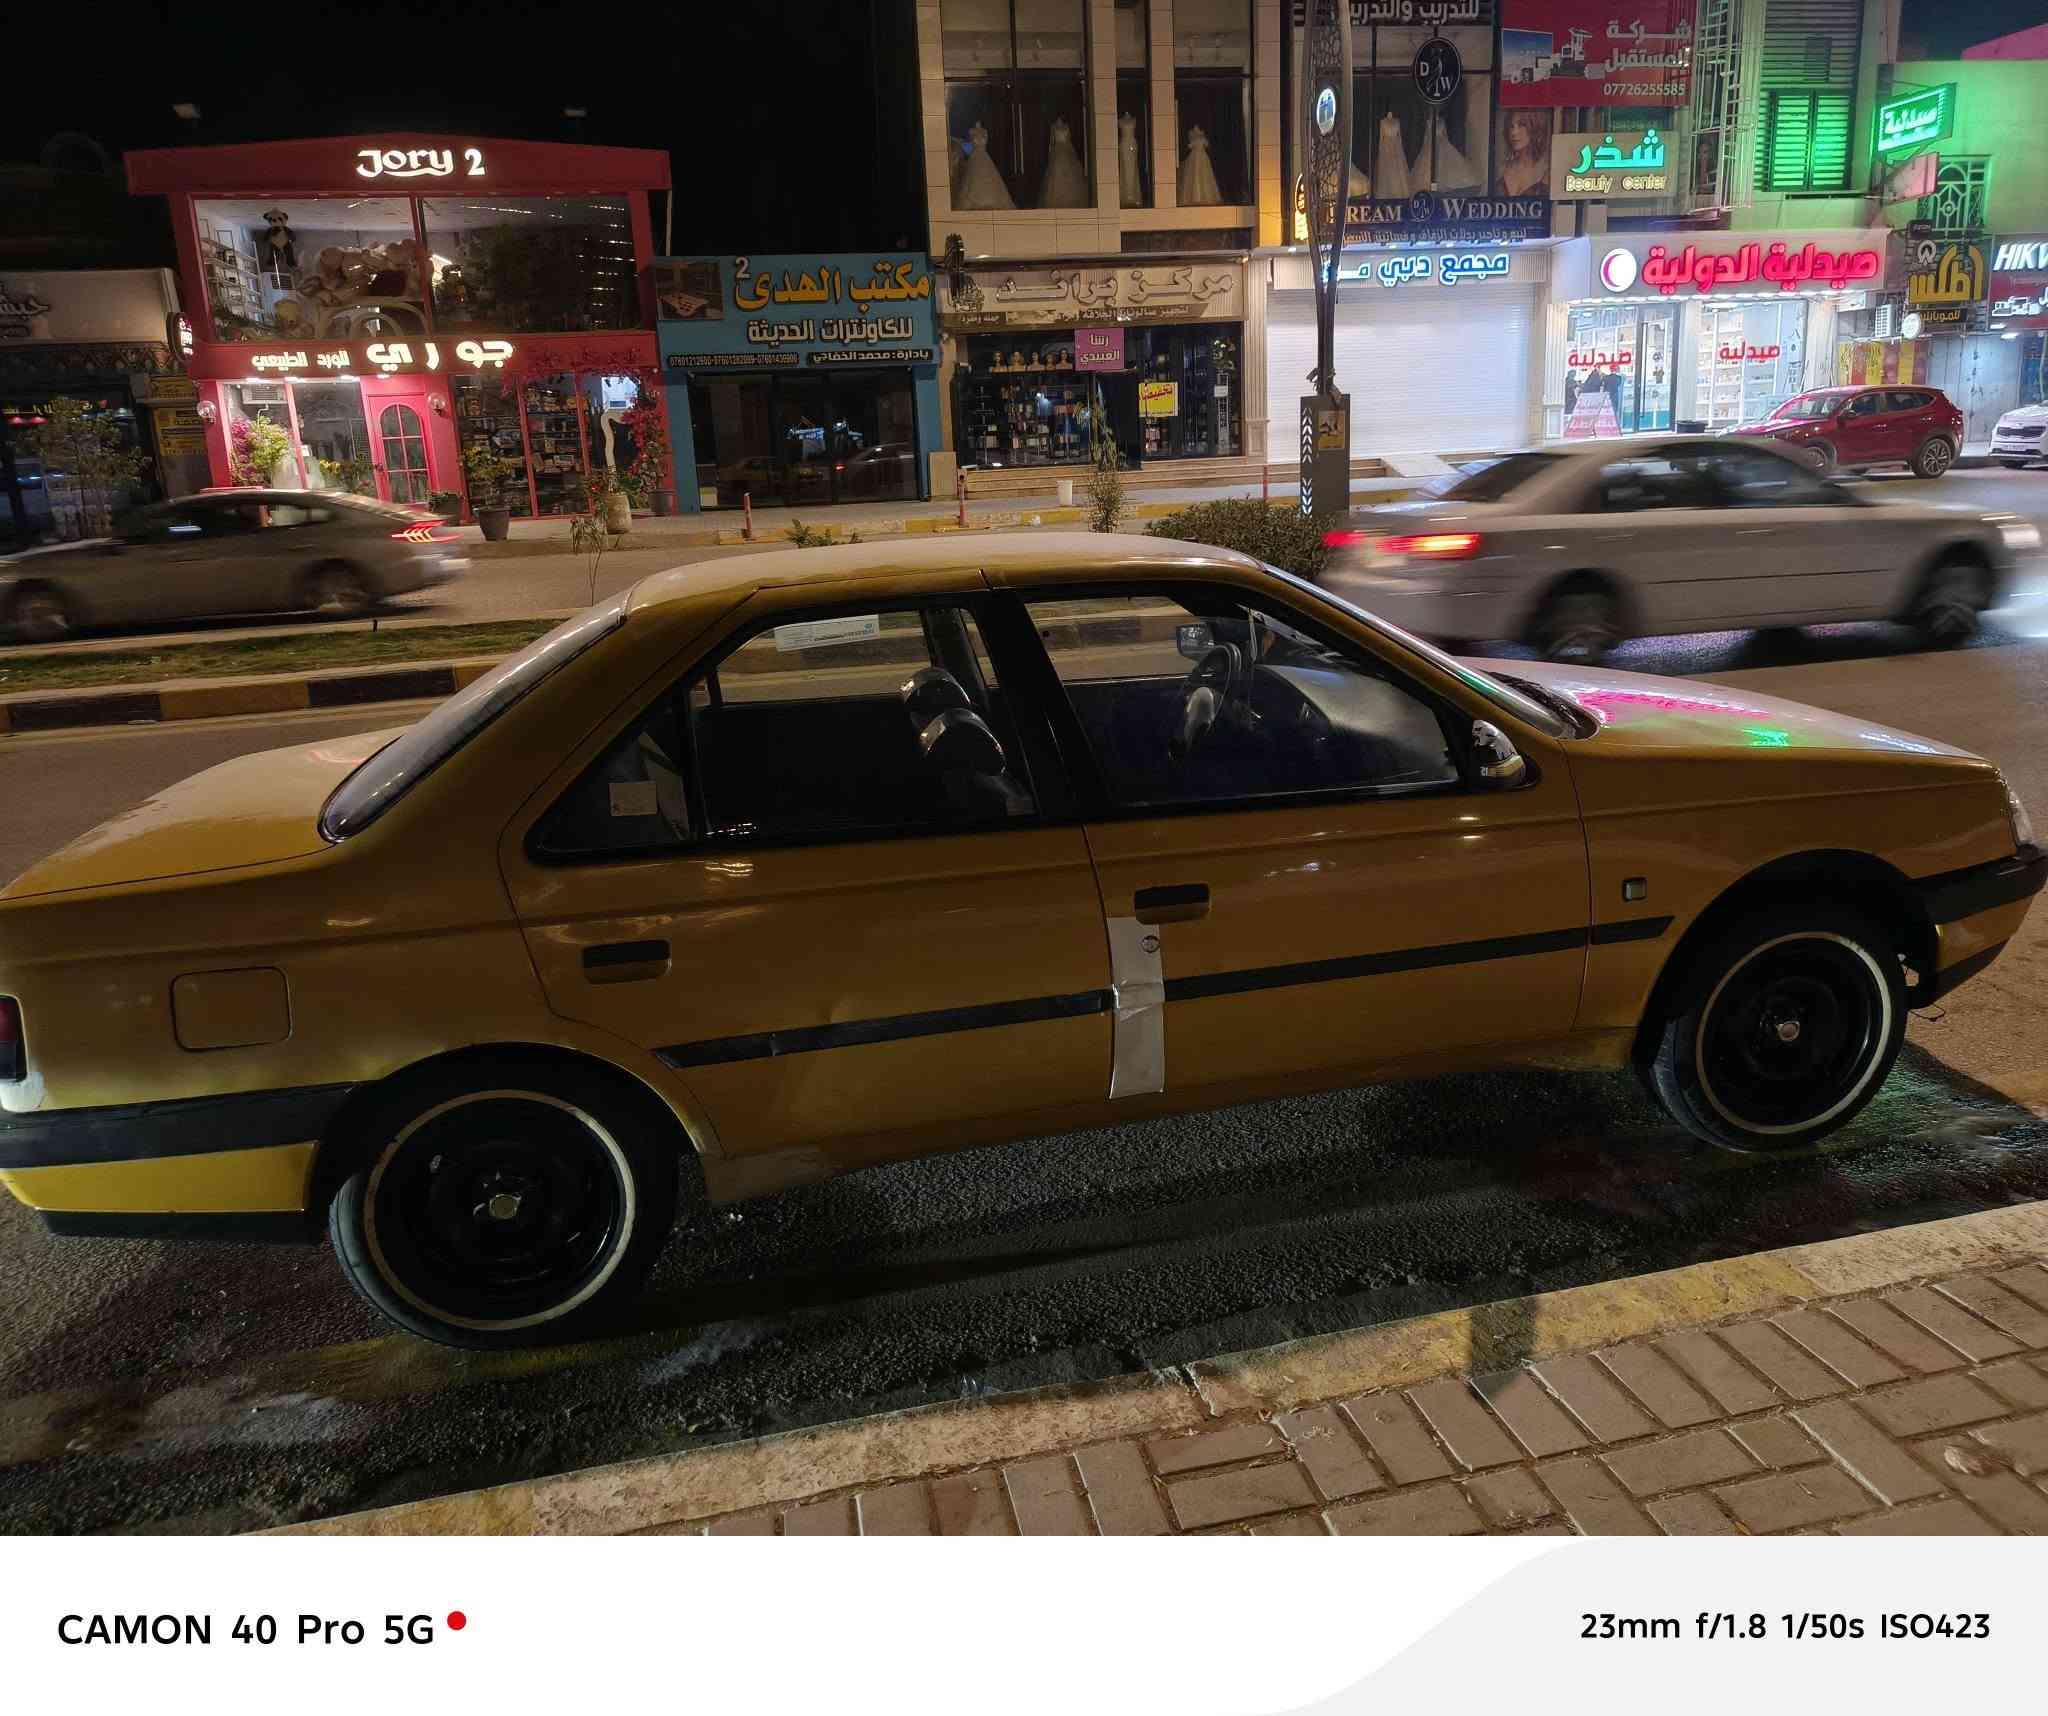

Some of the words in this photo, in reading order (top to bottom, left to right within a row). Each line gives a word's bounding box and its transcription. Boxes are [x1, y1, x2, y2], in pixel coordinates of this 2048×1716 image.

[1350, 0, 1414, 25] والتدري
[1603, 83, 1686, 97] 07726255585
[356, 149, 454, 178] Jory
[464, 148, 486, 176] 2
[1569, 129, 1664, 174] شذر
[1565, 174, 1613, 193] Beauty
[734, 256, 751, 279] 2
[1377, 256, 1432, 287] دبي
[1439, 254, 1509, 285] مجمع
[1643, 244, 1760, 294] الدولية
[1763, 243, 1878, 290] صيدلية
[848, 260, 930, 313] مكتب
[1129, 267, 1234, 303] مركز
[747, 319, 816, 347] الحديثة
[820, 318, 913, 346] للكاونترات
[1568, 346, 1632, 371] صيدلية
[1719, 339, 1781, 362] صيدلية
